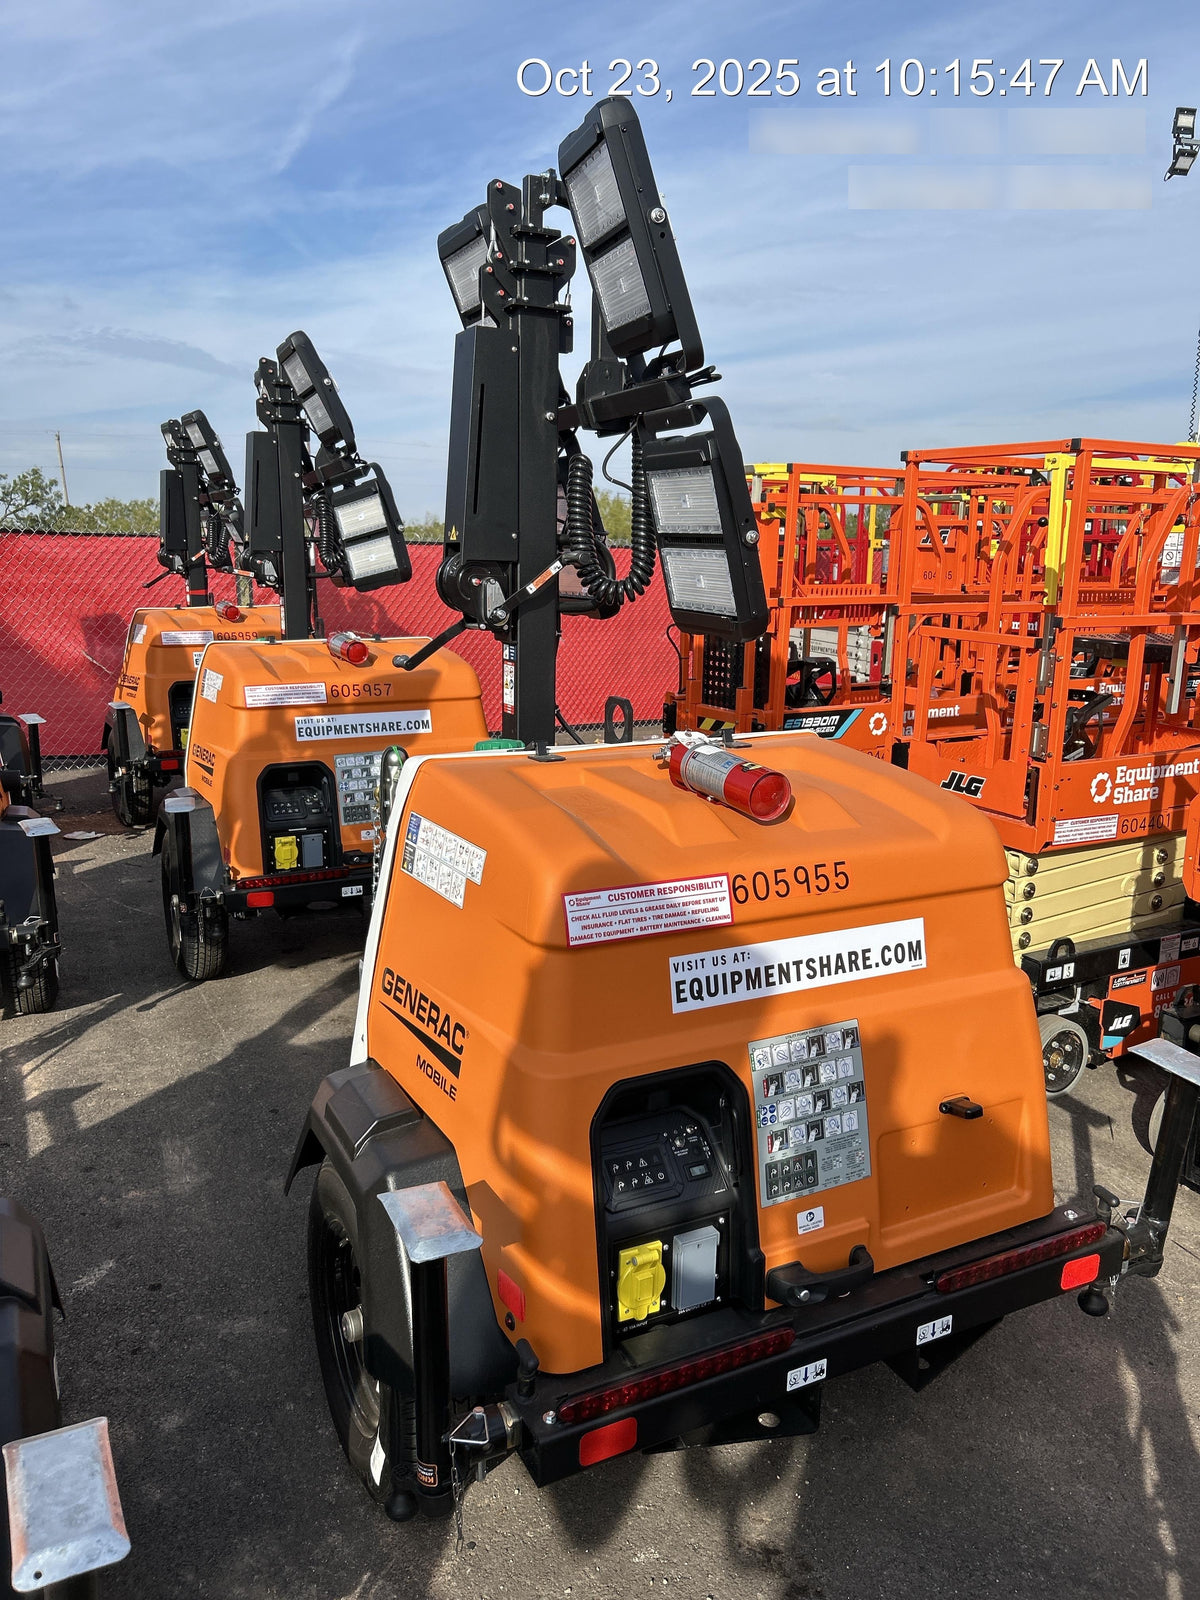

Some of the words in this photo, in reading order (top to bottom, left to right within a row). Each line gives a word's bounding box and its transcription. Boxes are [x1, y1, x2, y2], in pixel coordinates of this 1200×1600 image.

[217, 631, 258, 640] 605959
[330, 683, 392, 698] 605957
[297, 719, 431, 738] EQUIPMENTSHARE.COM
[784, 715, 840, 729] ES1930M
[1115, 758, 1200, 786] Equipment
[940, 770, 987, 798] JLG
[1113, 786, 1159, 805] Share
[1121, 812, 1171, 834] 604401
[608, 889, 655, 902] CUSTOMER
[657, 880, 724, 896] RESPONSIBILITY
[731, 860, 850, 904] 605955
[571, 914, 590, 922] CHECK
[619, 907, 639, 916] LEVELS
[682, 899, 701, 907] BEFORE
[581, 921, 613, 930] INSURANCE
[665, 910, 686, 918] DAMAGE
[691, 907, 719, 915] REFUELING
[571, 933, 594, 942] DAMAGE
[603, 927, 635, 937] EQUIPMENT
[640, 923, 663, 932] BATTERY
[664, 918, 701, 928] MAINTENANCE
[706, 914, 731, 923] CLEANING
[673, 958, 706, 973] VISIT
[712, 954, 727, 967] US
[732, 951, 751, 963] AT:
[675, 939, 923, 1003] EQUIPMENTSHARE.COM
[382, 966, 467, 1056] GENERAC
[1108, 1014, 1133, 1031] JLG
[416, 1054, 457, 1102] MOBILE
